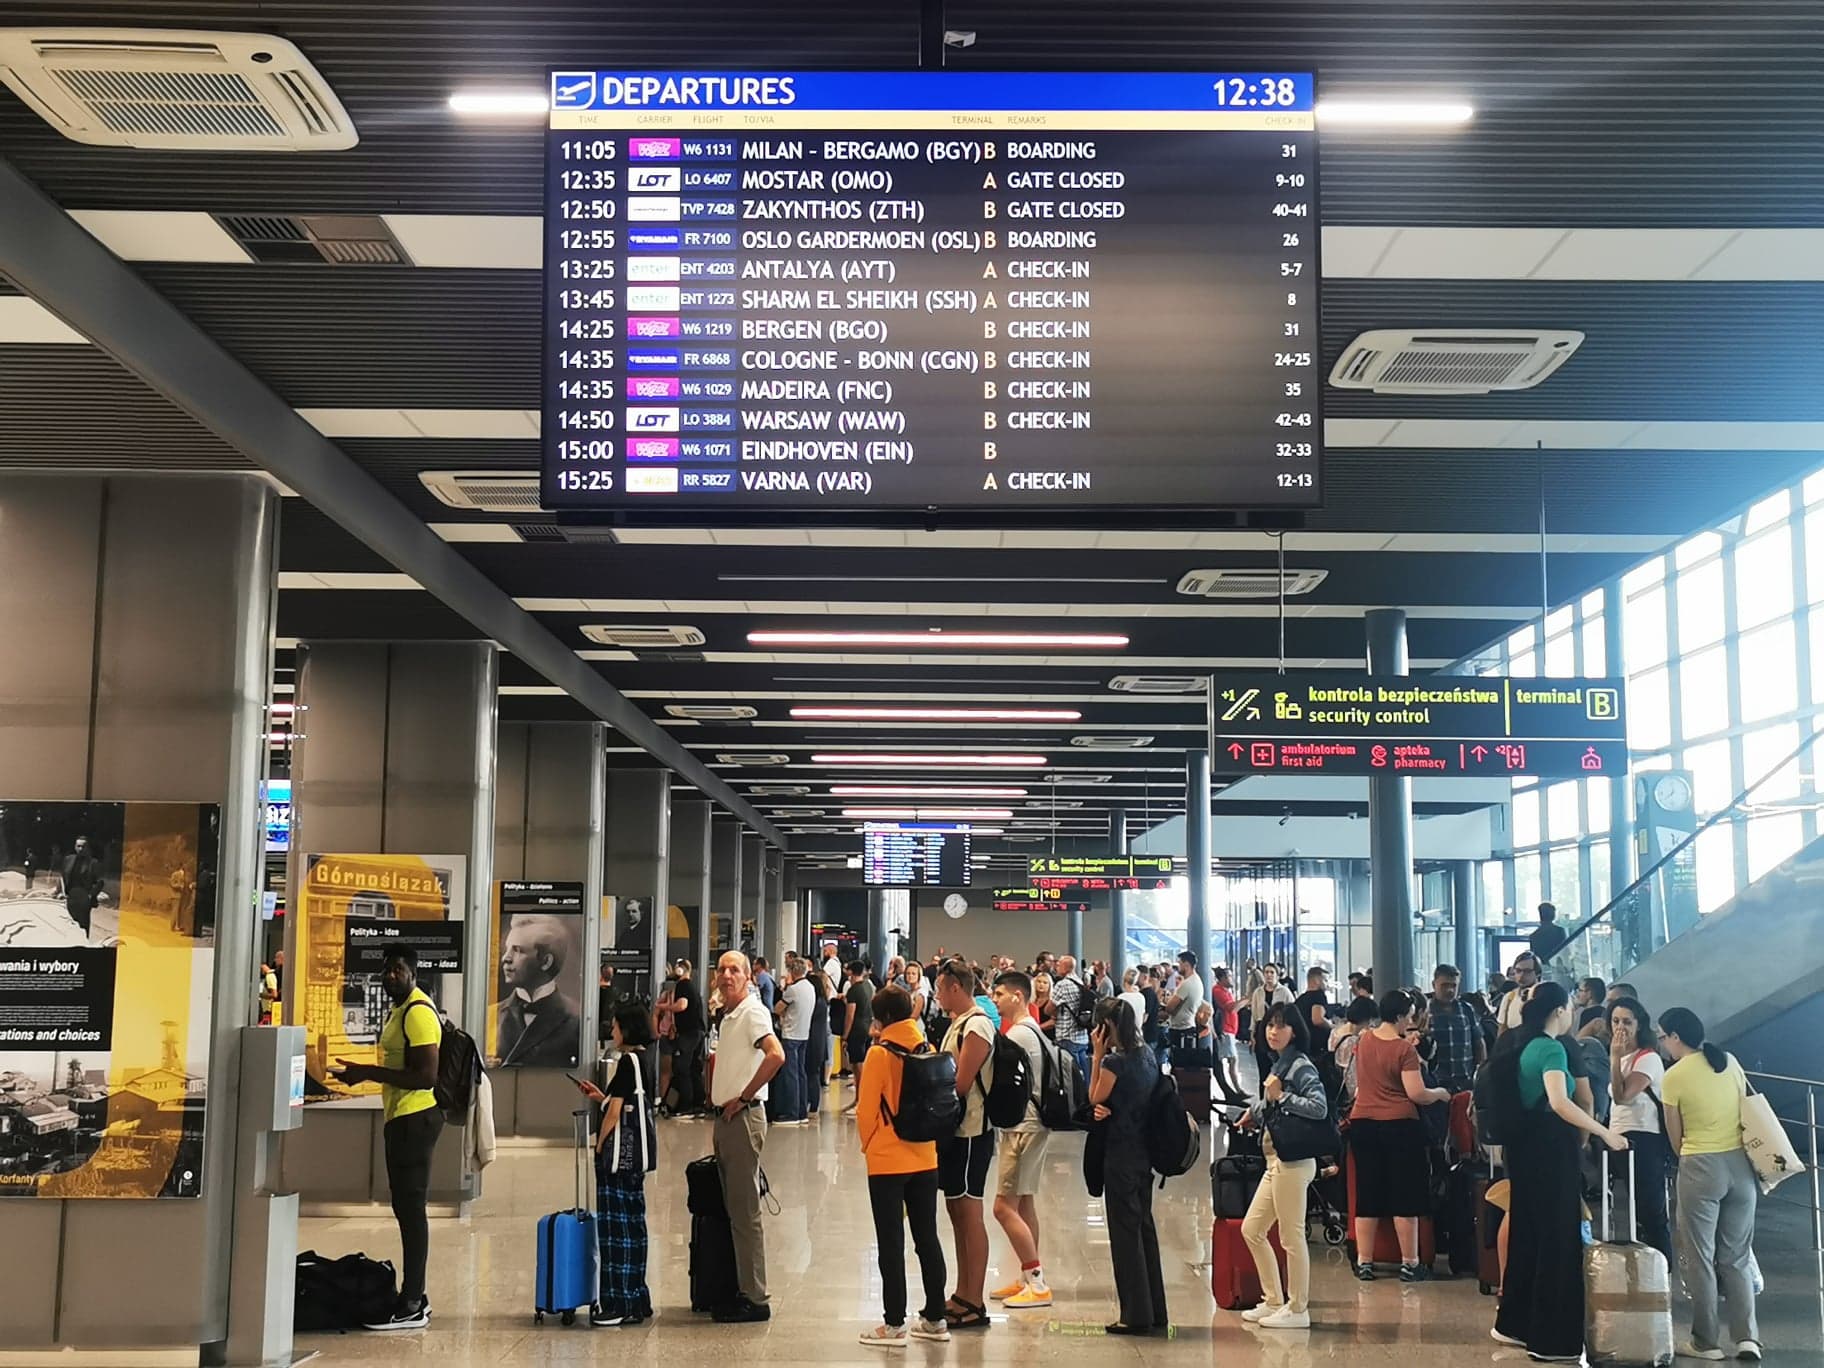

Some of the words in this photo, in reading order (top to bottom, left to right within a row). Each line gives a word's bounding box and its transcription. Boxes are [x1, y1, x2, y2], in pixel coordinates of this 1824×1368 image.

[602, 77, 796, 106] DEPARTURES
[1213, 78, 1295, 107] 12:38
[637, 115, 673, 125] CARRIER
[693, 115, 724, 125] FLIGHT
[744, 115, 775, 125] TO/VIA
[952, 115, 992, 125] TERMINAL
[1007, 115, 1047, 125] REMARKS
[562, 141, 615, 159] 11:05
[684, 144, 702, 155] W6
[706, 144, 731, 155] 1131
[743, 142, 802, 159] MILAN
[824, 142, 919, 159] BERGAMO
[926, 142, 980, 162] (BGY)
[984, 142, 996, 159] B
[1008, 142, 1095, 158] BOARDING
[1282, 145, 1296, 157] 31
[561, 171, 615, 189] 12:35
[637, 174, 672, 187] LOT
[685, 174, 701, 184] LO
[704, 174, 731, 184] 6407
[742, 171, 824, 189] MOSTAR
[832, 171, 892, 191] (OMO)
[983, 172, 996, 188] A
[1008, 172, 1054, 188] GATE
[1059, 172, 1124, 188] CLOSED
[1276, 174, 1304, 187] 9-10
[561, 200, 615, 218] 12:50
[680, 203, 704, 214] TVP
[707, 203, 734, 215] 7428
[743, 200, 862, 219] ZAKYNTHOS
[869, 201, 924, 221] (ZTH)
[985, 201, 996, 218] B
[1008, 202, 1054, 218] GATE
[1059, 202, 1124, 218] CLOSED
[1272, 204, 1306, 216] 40-41
[561, 230, 614, 248] 12:55
[685, 233, 700, 244] FR
[703, 233, 730, 244] 7100
[743, 231, 792, 248] OSLO
[797, 231, 924, 248] GARDERMOEN
[932, 231, 980, 251] (OSL)
[985, 231, 996, 248] B
[1008, 231, 1096, 248] BOARDING
[1283, 234, 1299, 246] 26
[560, 260, 614, 278] 13:25
[680, 263, 704, 274] ENT
[707, 263, 734, 274] 4203
[742, 260, 834, 279] ANTALYA
[841, 261, 895, 281] (AYT)
[983, 261, 997, 278] A
[1008, 261, 1089, 278] CHECK-IN
[1281, 263, 1302, 276] 5-7
[560, 290, 614, 308] 13:45
[680, 293, 704, 304] ENT
[707, 293, 734, 304] 1273
[742, 290, 811, 308] SHARM
[817, 290, 841, 308] EL
[847, 291, 917, 309] SHEIKH
[926, 291, 977, 311] (SSH)
[983, 292, 997, 308] A
[1008, 291, 1089, 308] CHECK-IN
[1288, 293, 1296, 305] 8
[560, 320, 614, 338] 14:25
[682, 323, 701, 334] W6
[705, 323, 732, 335] 1219
[743, 320, 821, 339] BERGEN
[829, 320, 887, 341] (BGO)
[985, 321, 996, 338] B
[1008, 321, 1089, 338] CHECK-IN
[1285, 323, 1298, 335] 31
[560, 350, 613, 368] 14:35
[685, 353, 700, 365] FR
[702, 353, 730, 365] 6868
[742, 351, 837, 369] COLOGNE
[859, 351, 913, 369] BONN
[921, 351, 978, 371] (CGN)
[985, 351, 996, 368] B
[1008, 351, 1089, 368] CHECK-IN
[1275, 353, 1310, 365] 24-25
[559, 381, 613, 399] 14:35
[682, 384, 701, 395] W6
[705, 384, 732, 395] 1029
[742, 381, 830, 399] MADEIRA
[837, 381, 892, 402] (FNC)
[984, 381, 996, 399] B
[1008, 382, 1090, 398] CHECK-IN
[1286, 383, 1301, 396] 35
[559, 411, 614, 429] 14:50
[635, 414, 671, 427] LOT
[684, 414, 700, 425] LO
[703, 414, 730, 425] 3884
[741, 411, 832, 429] WARSAW
[839, 411, 905, 432] (WAW)
[985, 412, 996, 429] B
[1008, 412, 1090, 428] CHECK-IN
[1275, 414, 1311, 426] 42-43
[558, 441, 613, 459] 15:00
[682, 444, 701, 455] W6
[704, 444, 730, 455] 1071
[742, 441, 857, 460] EINDHOVEN
[865, 442, 913, 462] (EIN)
[985, 442, 996, 459] B
[1276, 444, 1311, 456] 32-33
[558, 471, 612, 489] 15:25
[684, 474, 699, 485] RR
[702, 474, 730, 486] 5827
[741, 472, 810, 490] VARNA
[817, 472, 871, 493] (VAR)
[983, 473, 997, 489] A
[1008, 473, 1090, 489] CHECK-IN
[1277, 474, 1312, 486] 12-13
[1221, 689, 1236, 702] +1
[1309, 686, 1373, 702] kontrola
[1378, 686, 1499, 706] bezpieczeństwa
[1516, 688, 1582, 704] terminal
[1594, 692, 1611, 716] B
[1309, 707, 1371, 726] security
[1375, 708, 1430, 724] control
[1281, 743, 1356, 755] ambulatorium
[1393, 744, 1431, 757] apteka
[1281, 756, 1304, 767] first
[1309, 756, 1323, 767] aid
[1395, 757, 1447, 770] pharmacy
[350, 927, 378, 938] Polityka
[0, 959, 31, 972] wania
[33, 959, 37, 972] i
[39, 960, 80, 975] wybory
[0, 1028, 34, 1041] ations
[36, 1029, 57, 1041] and
[58, 1028, 101, 1041] choices
